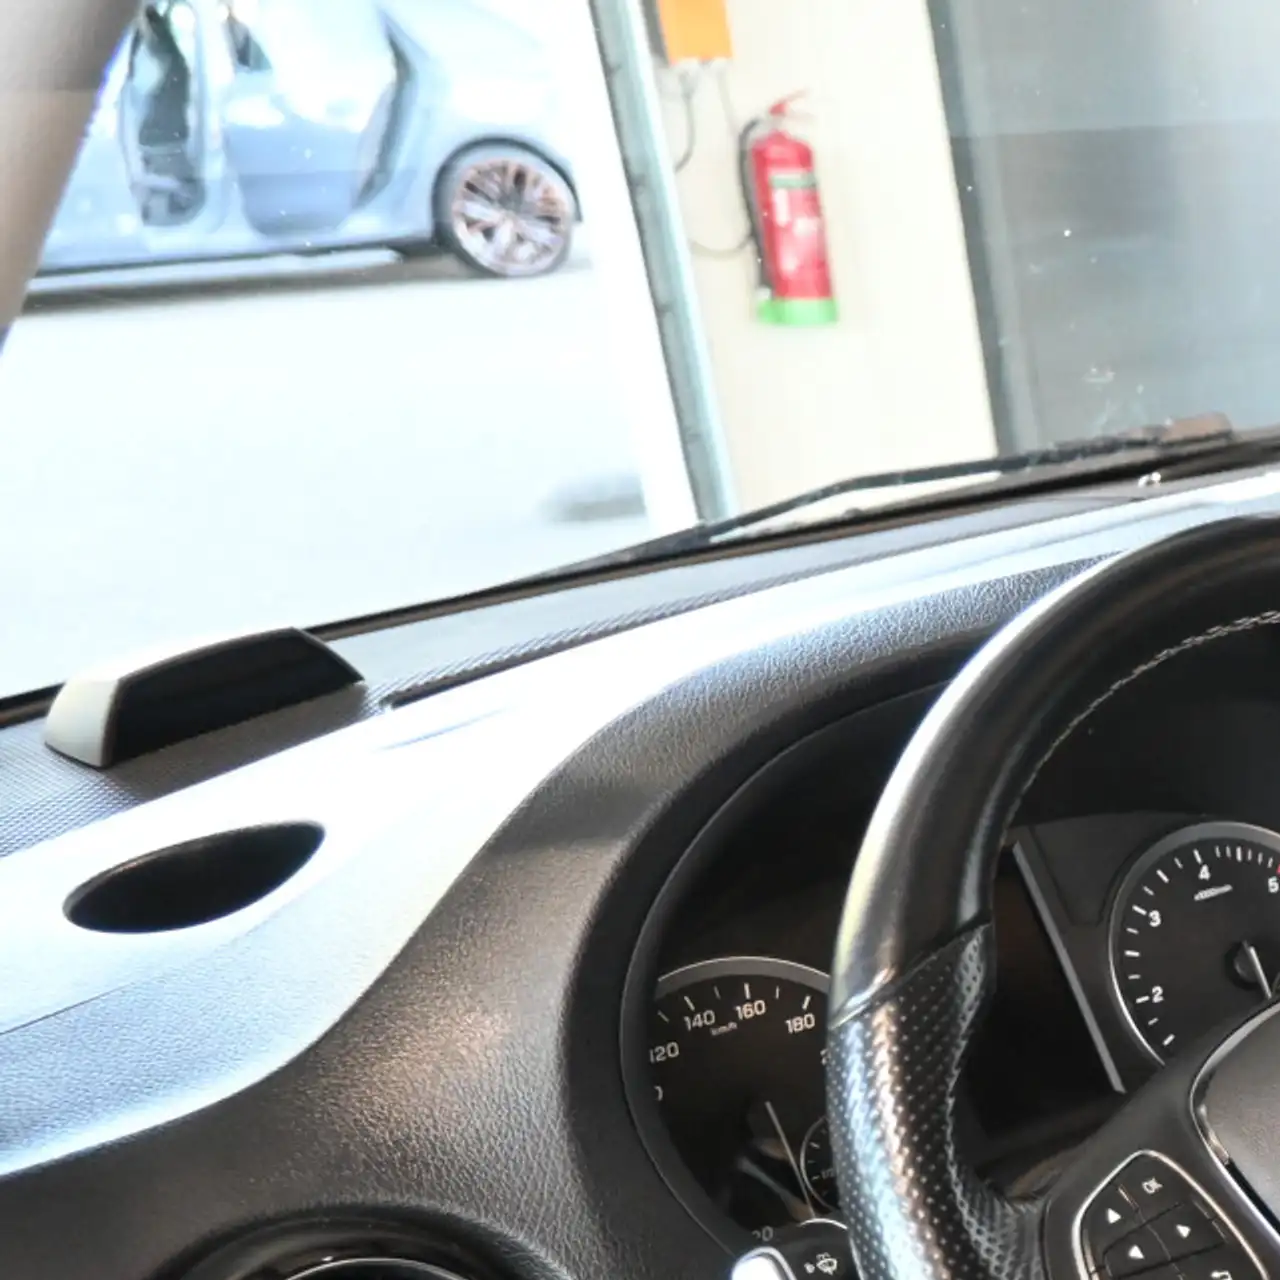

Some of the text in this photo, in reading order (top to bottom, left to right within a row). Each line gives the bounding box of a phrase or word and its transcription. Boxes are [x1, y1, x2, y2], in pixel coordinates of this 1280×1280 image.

[1199, 865, 1210, 880] 4
[1268, 876, 1279, 893] 5
[1149, 910, 1161, 927] 3
[1152, 986, 1163, 1002] 2
[735, 1000, 766, 1020] 160
[684, 1010, 715, 1031] 140
[785, 1013, 815, 1034] 180
[650, 1042, 679, 1063] 120
